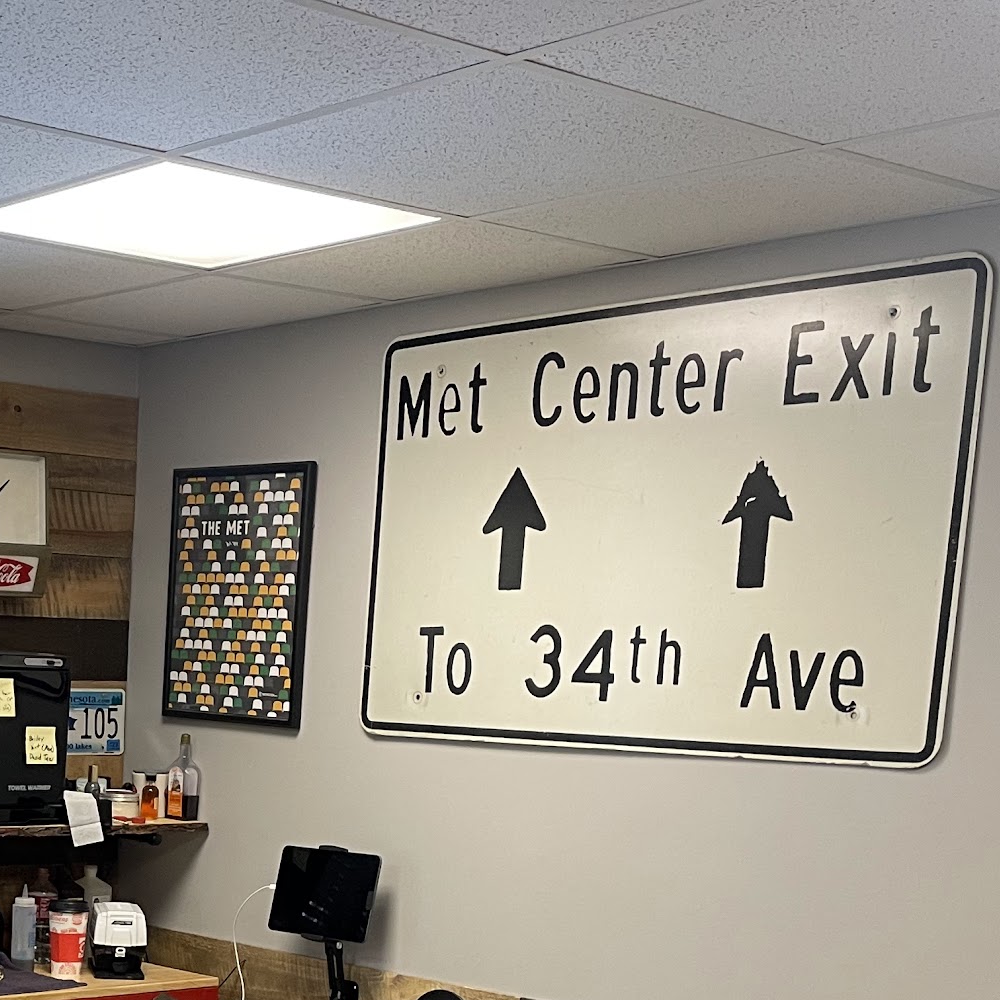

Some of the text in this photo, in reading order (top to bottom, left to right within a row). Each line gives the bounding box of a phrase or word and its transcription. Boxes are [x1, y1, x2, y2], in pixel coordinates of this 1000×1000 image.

[396, 305, 941, 440] Met Center Exit
[201, 520, 251, 536] THE MET
[419, 624, 865, 714] To 34th Ave
[81, 707, 119, 739] 105
